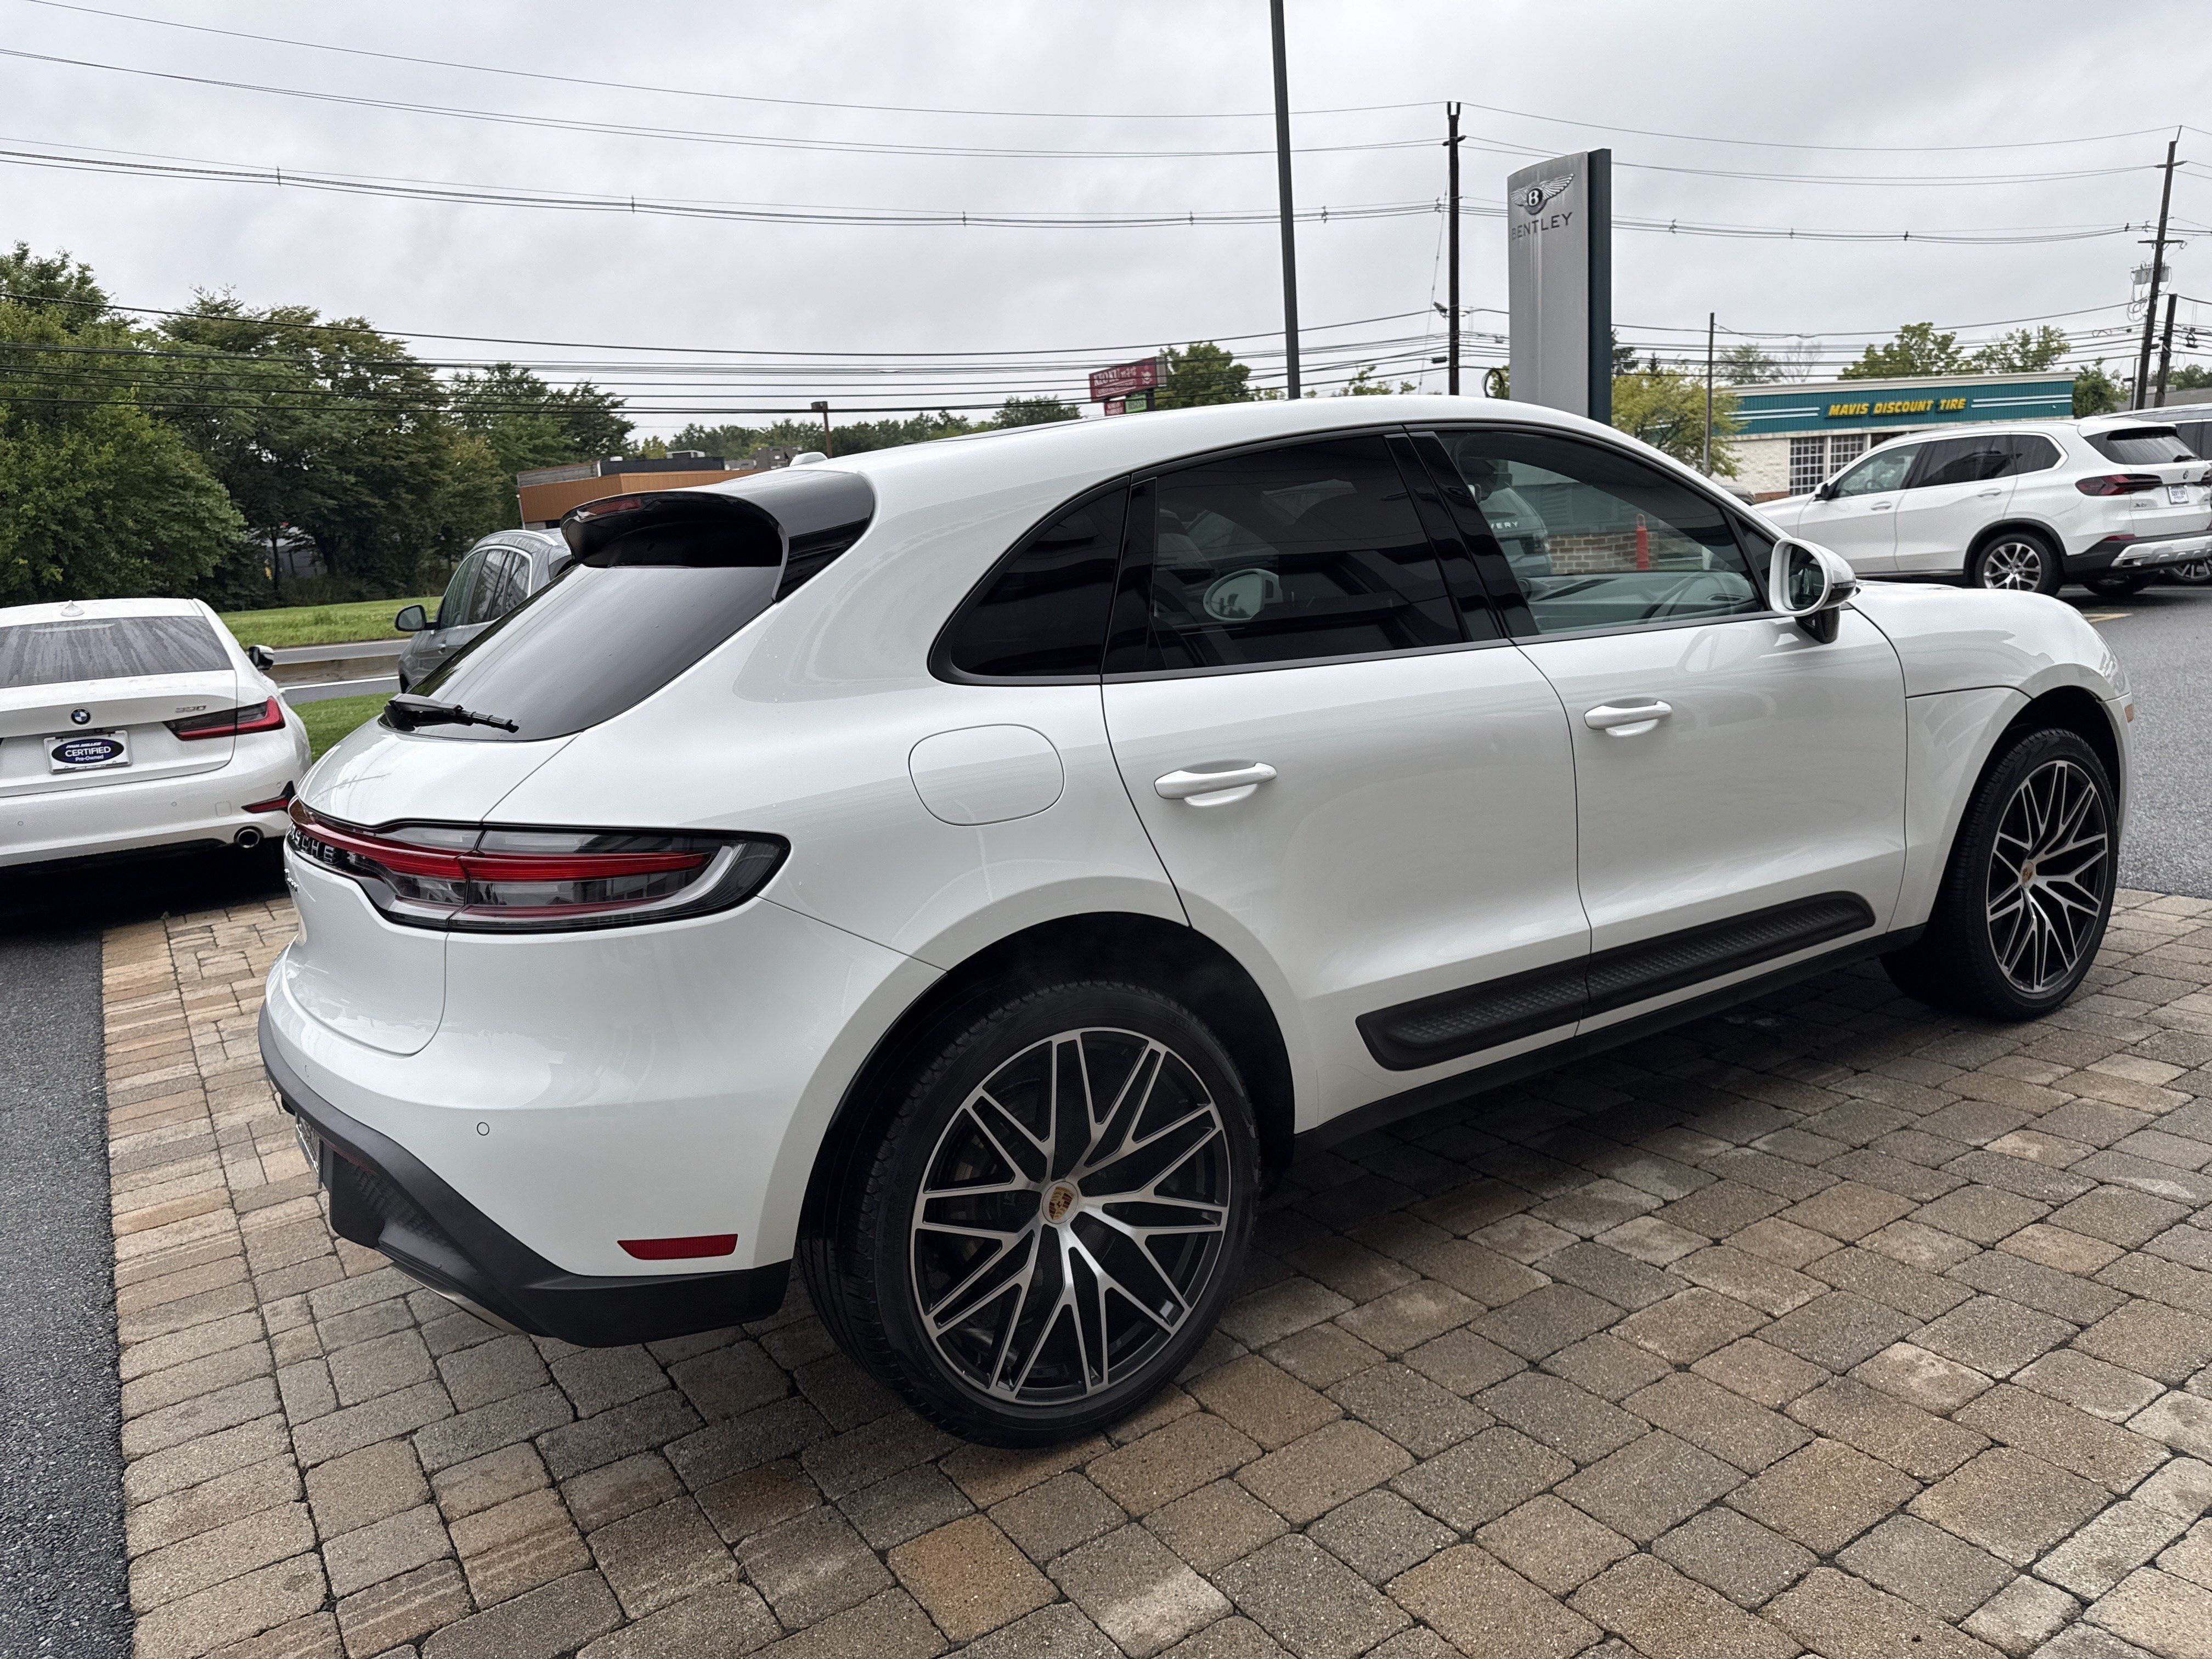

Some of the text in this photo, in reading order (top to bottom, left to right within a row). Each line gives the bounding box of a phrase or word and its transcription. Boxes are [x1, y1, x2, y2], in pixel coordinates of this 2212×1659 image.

[1511, 211, 1573, 240] BENTLEY
[1828, 398, 1967, 416] MAVIS DISCOUNT TIRE
[65, 746, 111, 757] CERTIFIED
